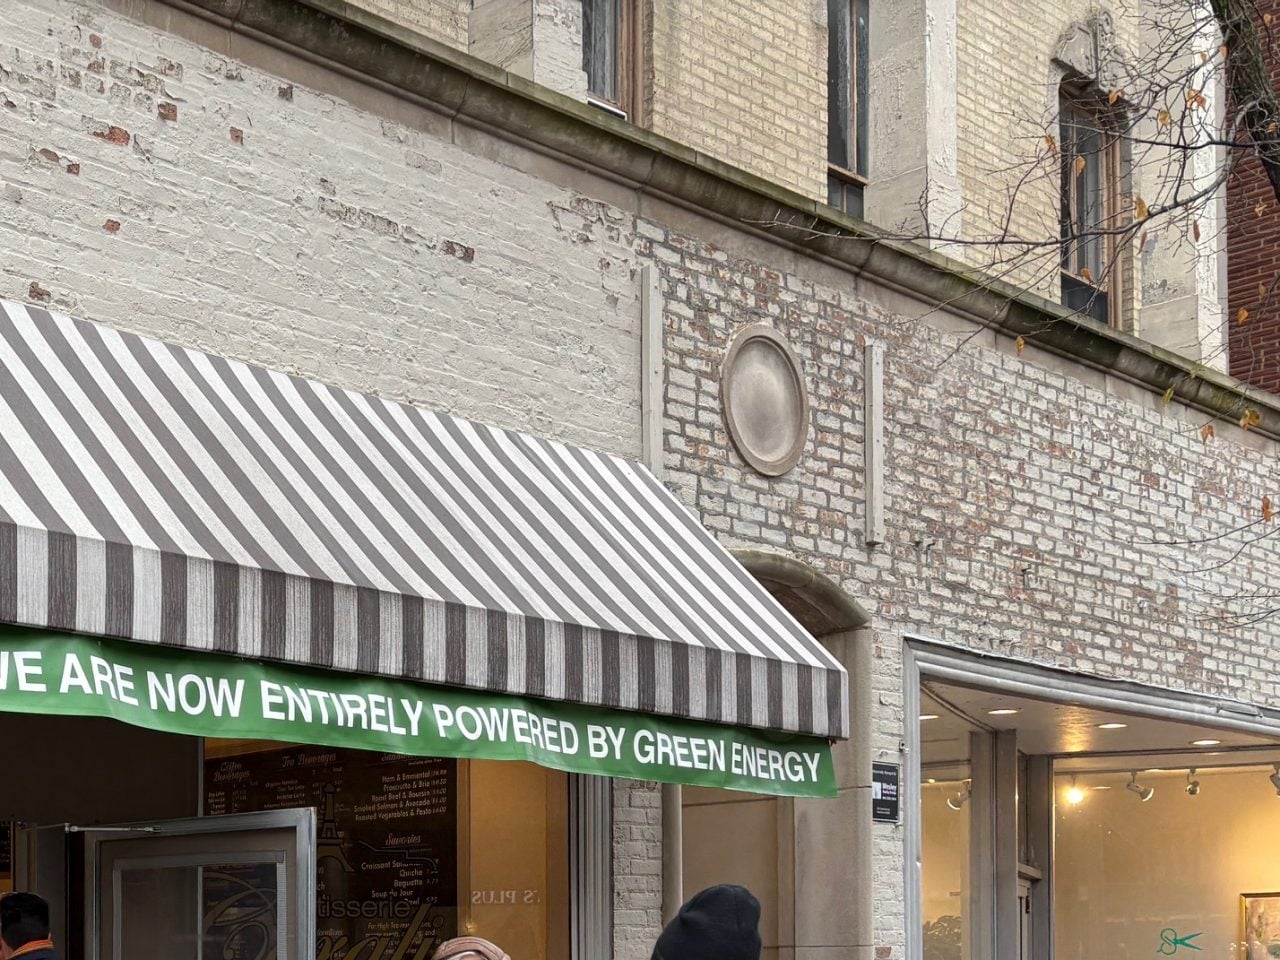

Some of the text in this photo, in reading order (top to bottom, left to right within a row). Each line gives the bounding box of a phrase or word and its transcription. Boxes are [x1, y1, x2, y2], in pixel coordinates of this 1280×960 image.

[59, 653, 139, 706] ARE
[148, 671, 244, 718] NOW
[261, 680, 422, 736] ENTIRELY
[432, 703, 579, 756] POWERED
[587, 725, 626, 760] BY
[633, 729, 726, 772] GREEN
[731, 742, 821, 783] ENERGY
[316, 896, 411, 918] tisserie
